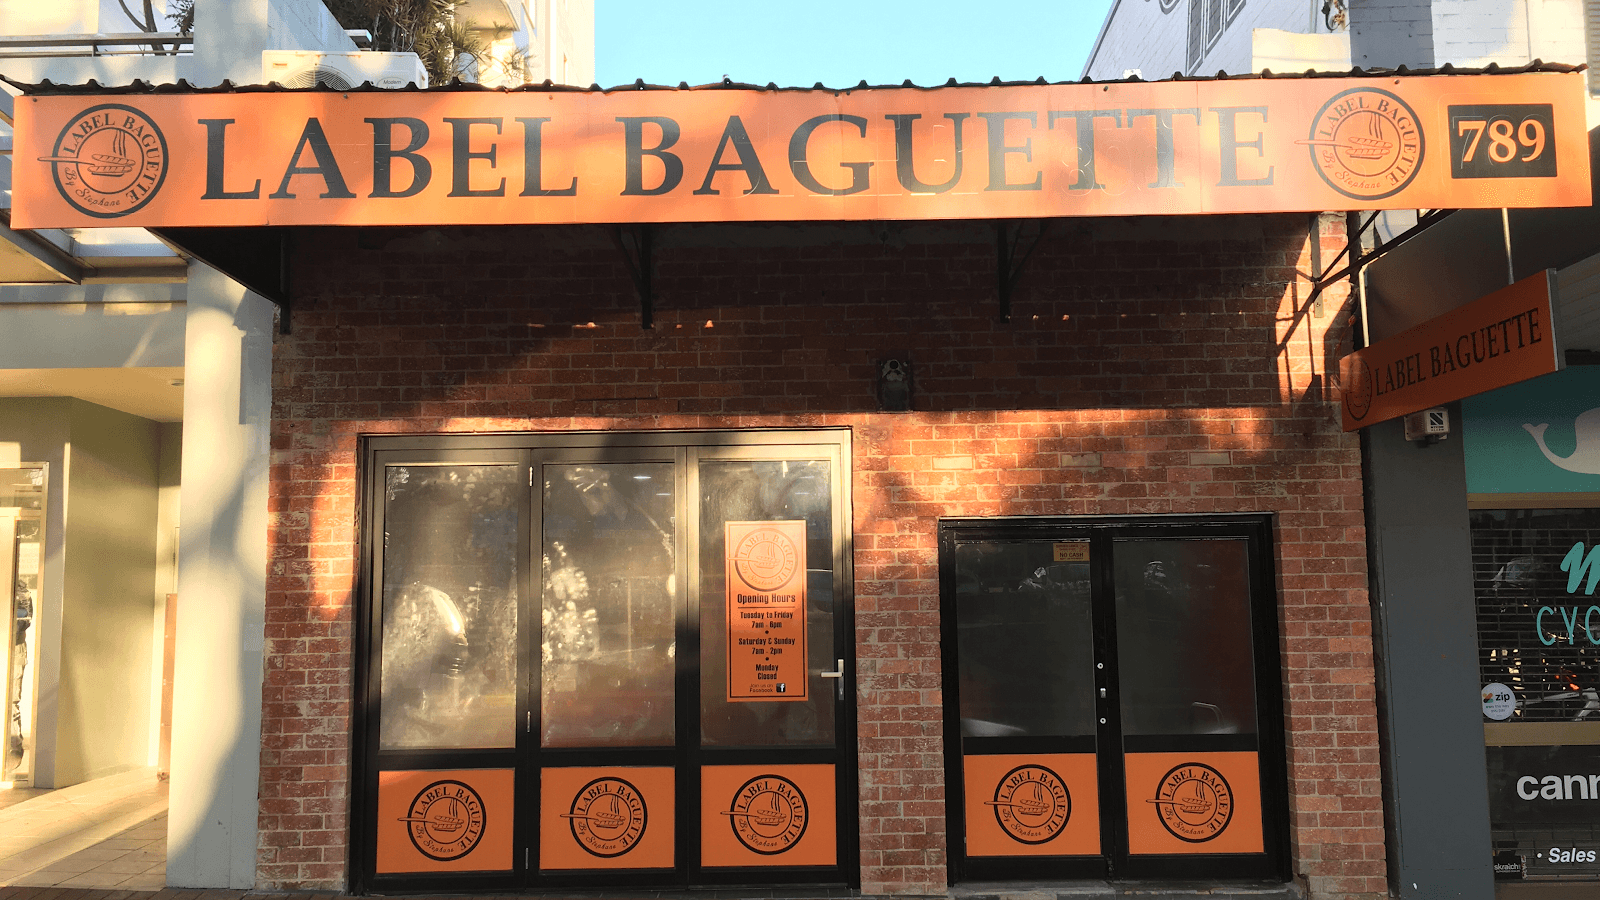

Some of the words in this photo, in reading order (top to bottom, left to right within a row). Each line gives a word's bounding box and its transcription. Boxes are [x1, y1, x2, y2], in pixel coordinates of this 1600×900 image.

[63, 113, 115, 153] LABEL
[123, 115, 160, 204] BAGUETTE
[198, 117, 578, 201] LABEL
[615, 105, 1275, 197] BAGUETTE
[1319, 97, 1370, 137] LABEL
[1377, 99, 1417, 186] BAGUETTE
[1458, 119, 1546, 163] 789
[64, 167, 78, 187] By
[75, 188, 121, 206] Stephane
[1322, 149, 1336, 169] By
[1335, 170, 1381, 189] Stephane
[1374, 352, 1426, 396] LABEL
[1430, 307, 1542, 378] BAGUETTE
[740, 533, 769, 556] LABEL
[737, 593, 769, 605] Opening
[771, 593, 796, 603] Hours
[740, 611, 765, 620] Tuesday
[766, 611, 773, 619] to
[774, 611, 794, 620] Friday
[738, 637, 767, 646] Saturday
[774, 637, 796, 646] Sunday
[751, 620, 764, 629] 7am
[769, 620, 783, 629] 6pm
[1536, 605, 1600, 646] CYC
[751, 647, 765, 655] 7am
[769, 647, 783, 655] 2pm
[755, 663, 779, 672] Monday
[757, 672, 778, 680] Closed
[1495, 691, 1510, 702] zip
[414, 786, 451, 816] LABEL
[455, 788, 481, 851] BAGUETTE
[577, 784, 612, 813] LABEL
[616, 785, 642, 848] BAGUETTE
[737, 781, 772, 810] LABEL
[776, 783, 803, 845] BAGUETTE
[1000, 771, 1035, 800] LABEL
[1039, 772, 1066, 835] BAGUETTE
[1163, 769, 1197, 798] LABEL
[1201, 771, 1228, 833] BAGUETTE
[1548, 847, 1597, 863] Sales
